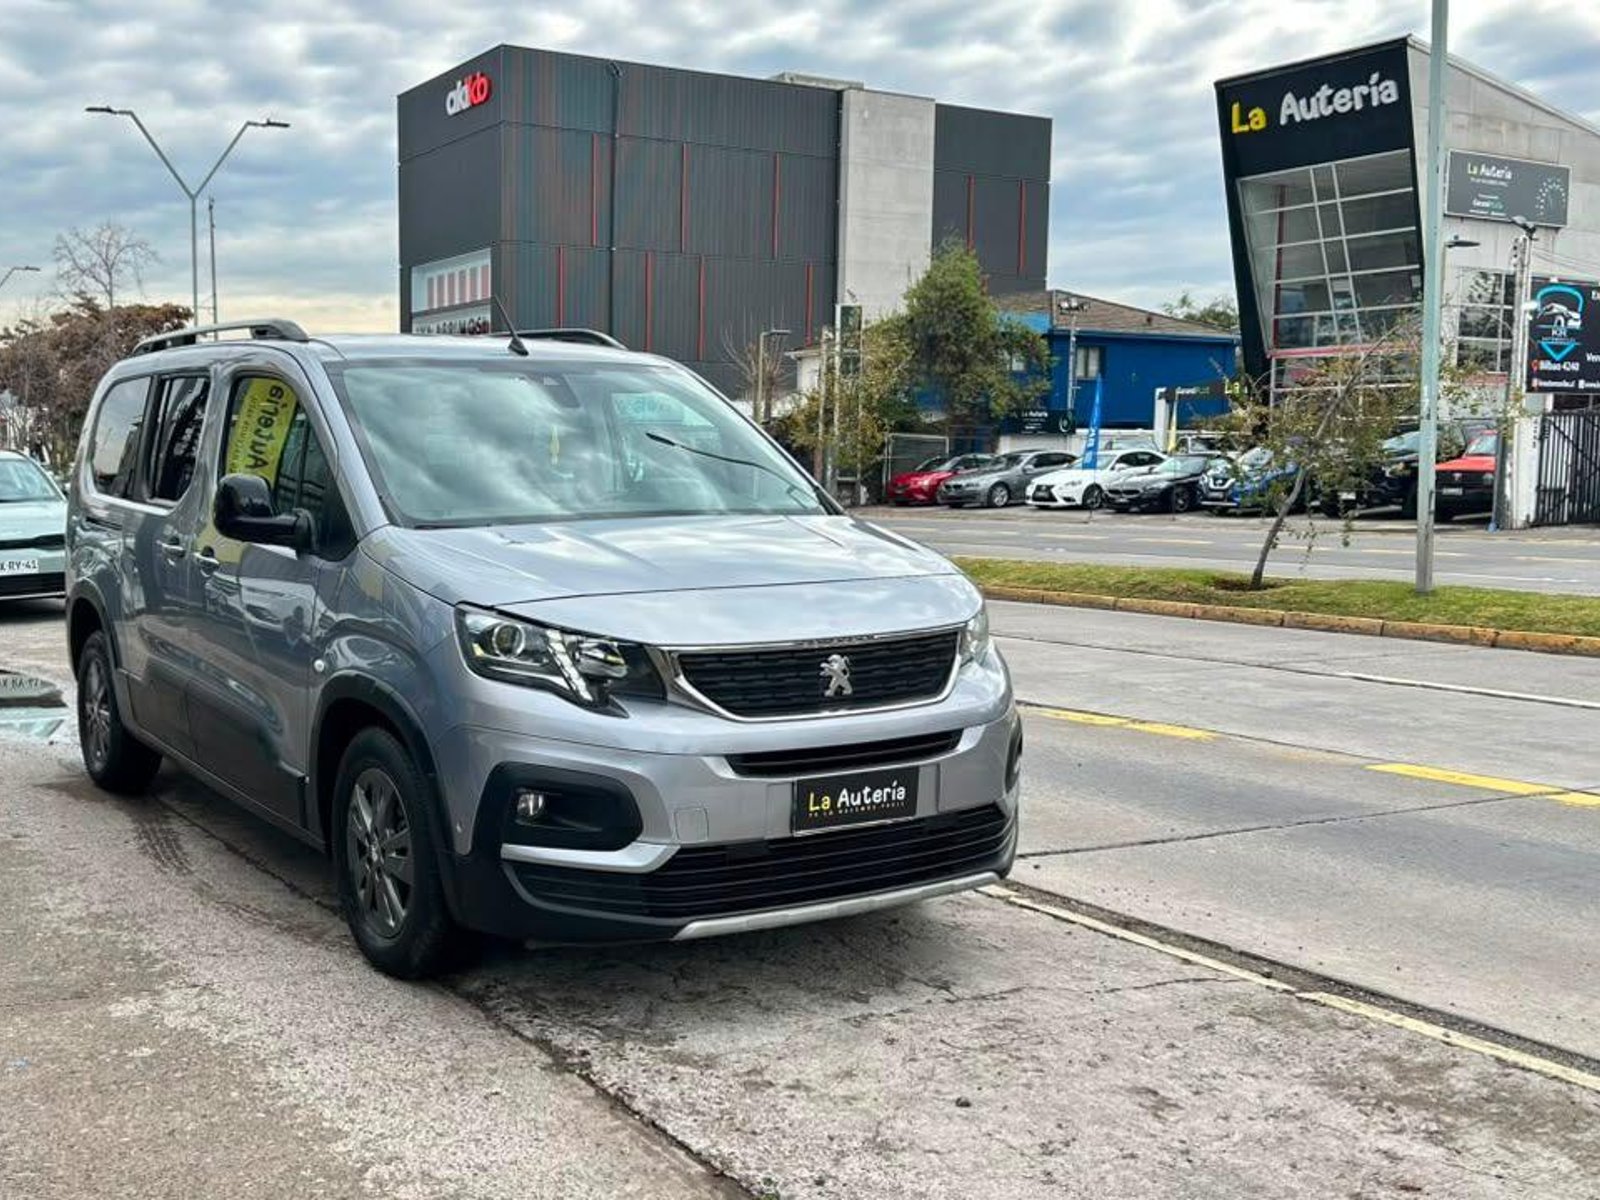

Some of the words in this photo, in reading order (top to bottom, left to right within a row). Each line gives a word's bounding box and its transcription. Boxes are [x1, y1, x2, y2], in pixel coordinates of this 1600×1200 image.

[1231, 101, 1268, 134] La
[1280, 70, 1399, 126] Autería
[1467, 162, 1478, 174] La
[808, 792, 831, 811] La
[837, 780, 906, 808] Autería
